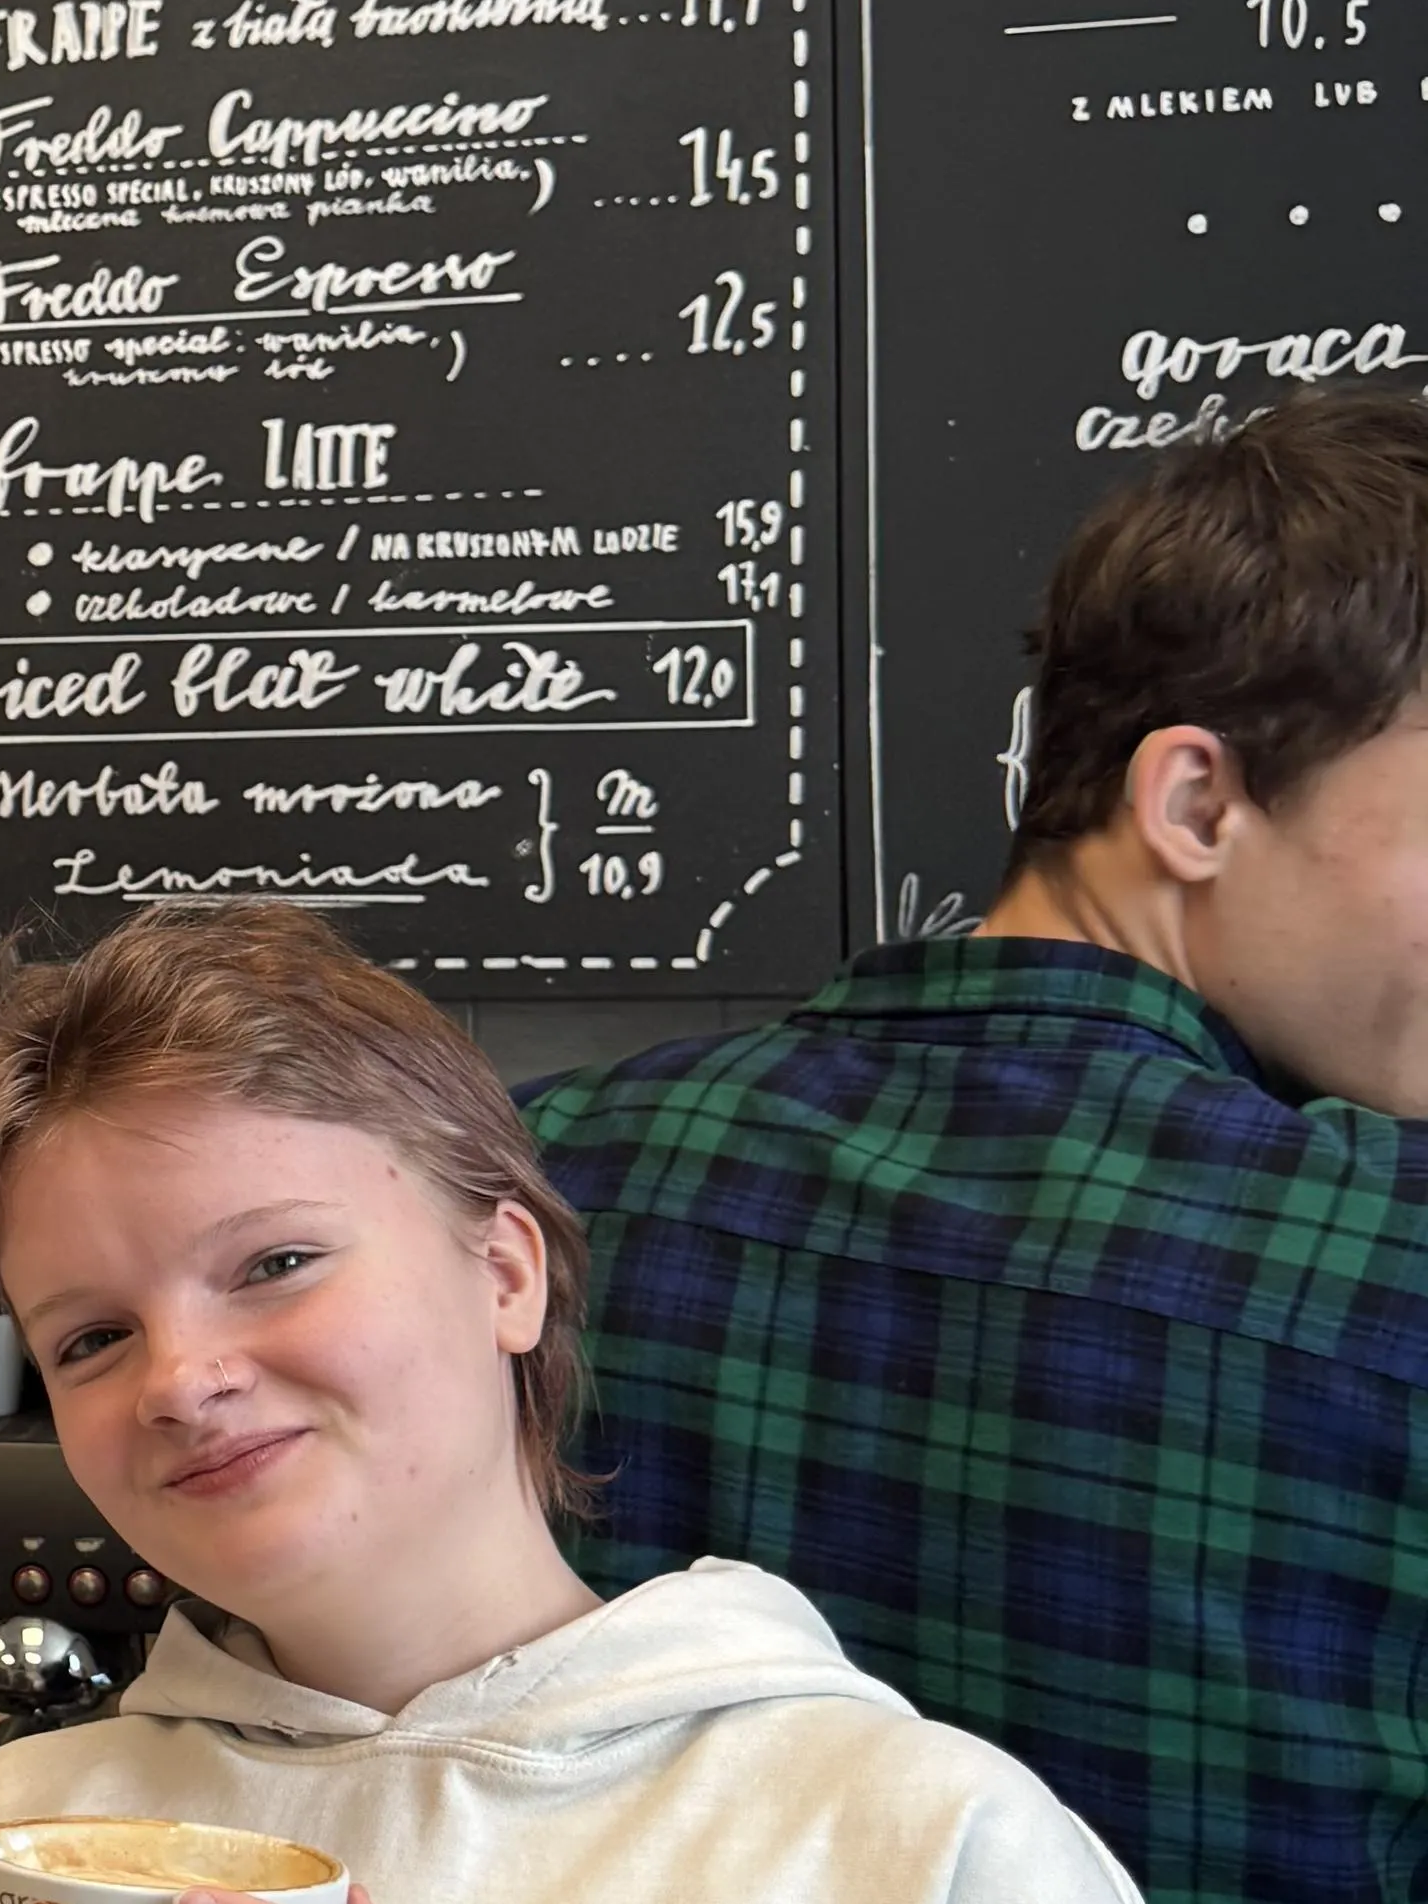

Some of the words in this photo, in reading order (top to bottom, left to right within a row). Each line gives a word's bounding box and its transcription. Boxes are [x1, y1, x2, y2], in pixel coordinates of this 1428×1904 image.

[192, 20, 215, 49] z
[1072, 97, 1090, 120] Z
[1107, 87, 1272, 118] MLEKIEM
[209, 90, 548, 169] Cappuccino
[307, 191, 434, 225] pianka
[235, 236, 522, 314] Espresso
[1122, 323, 1428, 400] gorąca
[262, 419, 395, 490] LATTE
[72, 537, 324, 579] klasyczne
[371, 533, 410, 560] NA
[417, 527, 580, 559] KRUSZONYM
[76, 585, 316, 621] czekoladowe
[368, 581, 613, 615] karmelowe
[171, 643, 360, 716] flat
[375, 642, 616, 716] white
[244, 774, 501, 813] mrożona
[53, 849, 489, 894] Lemoniada
